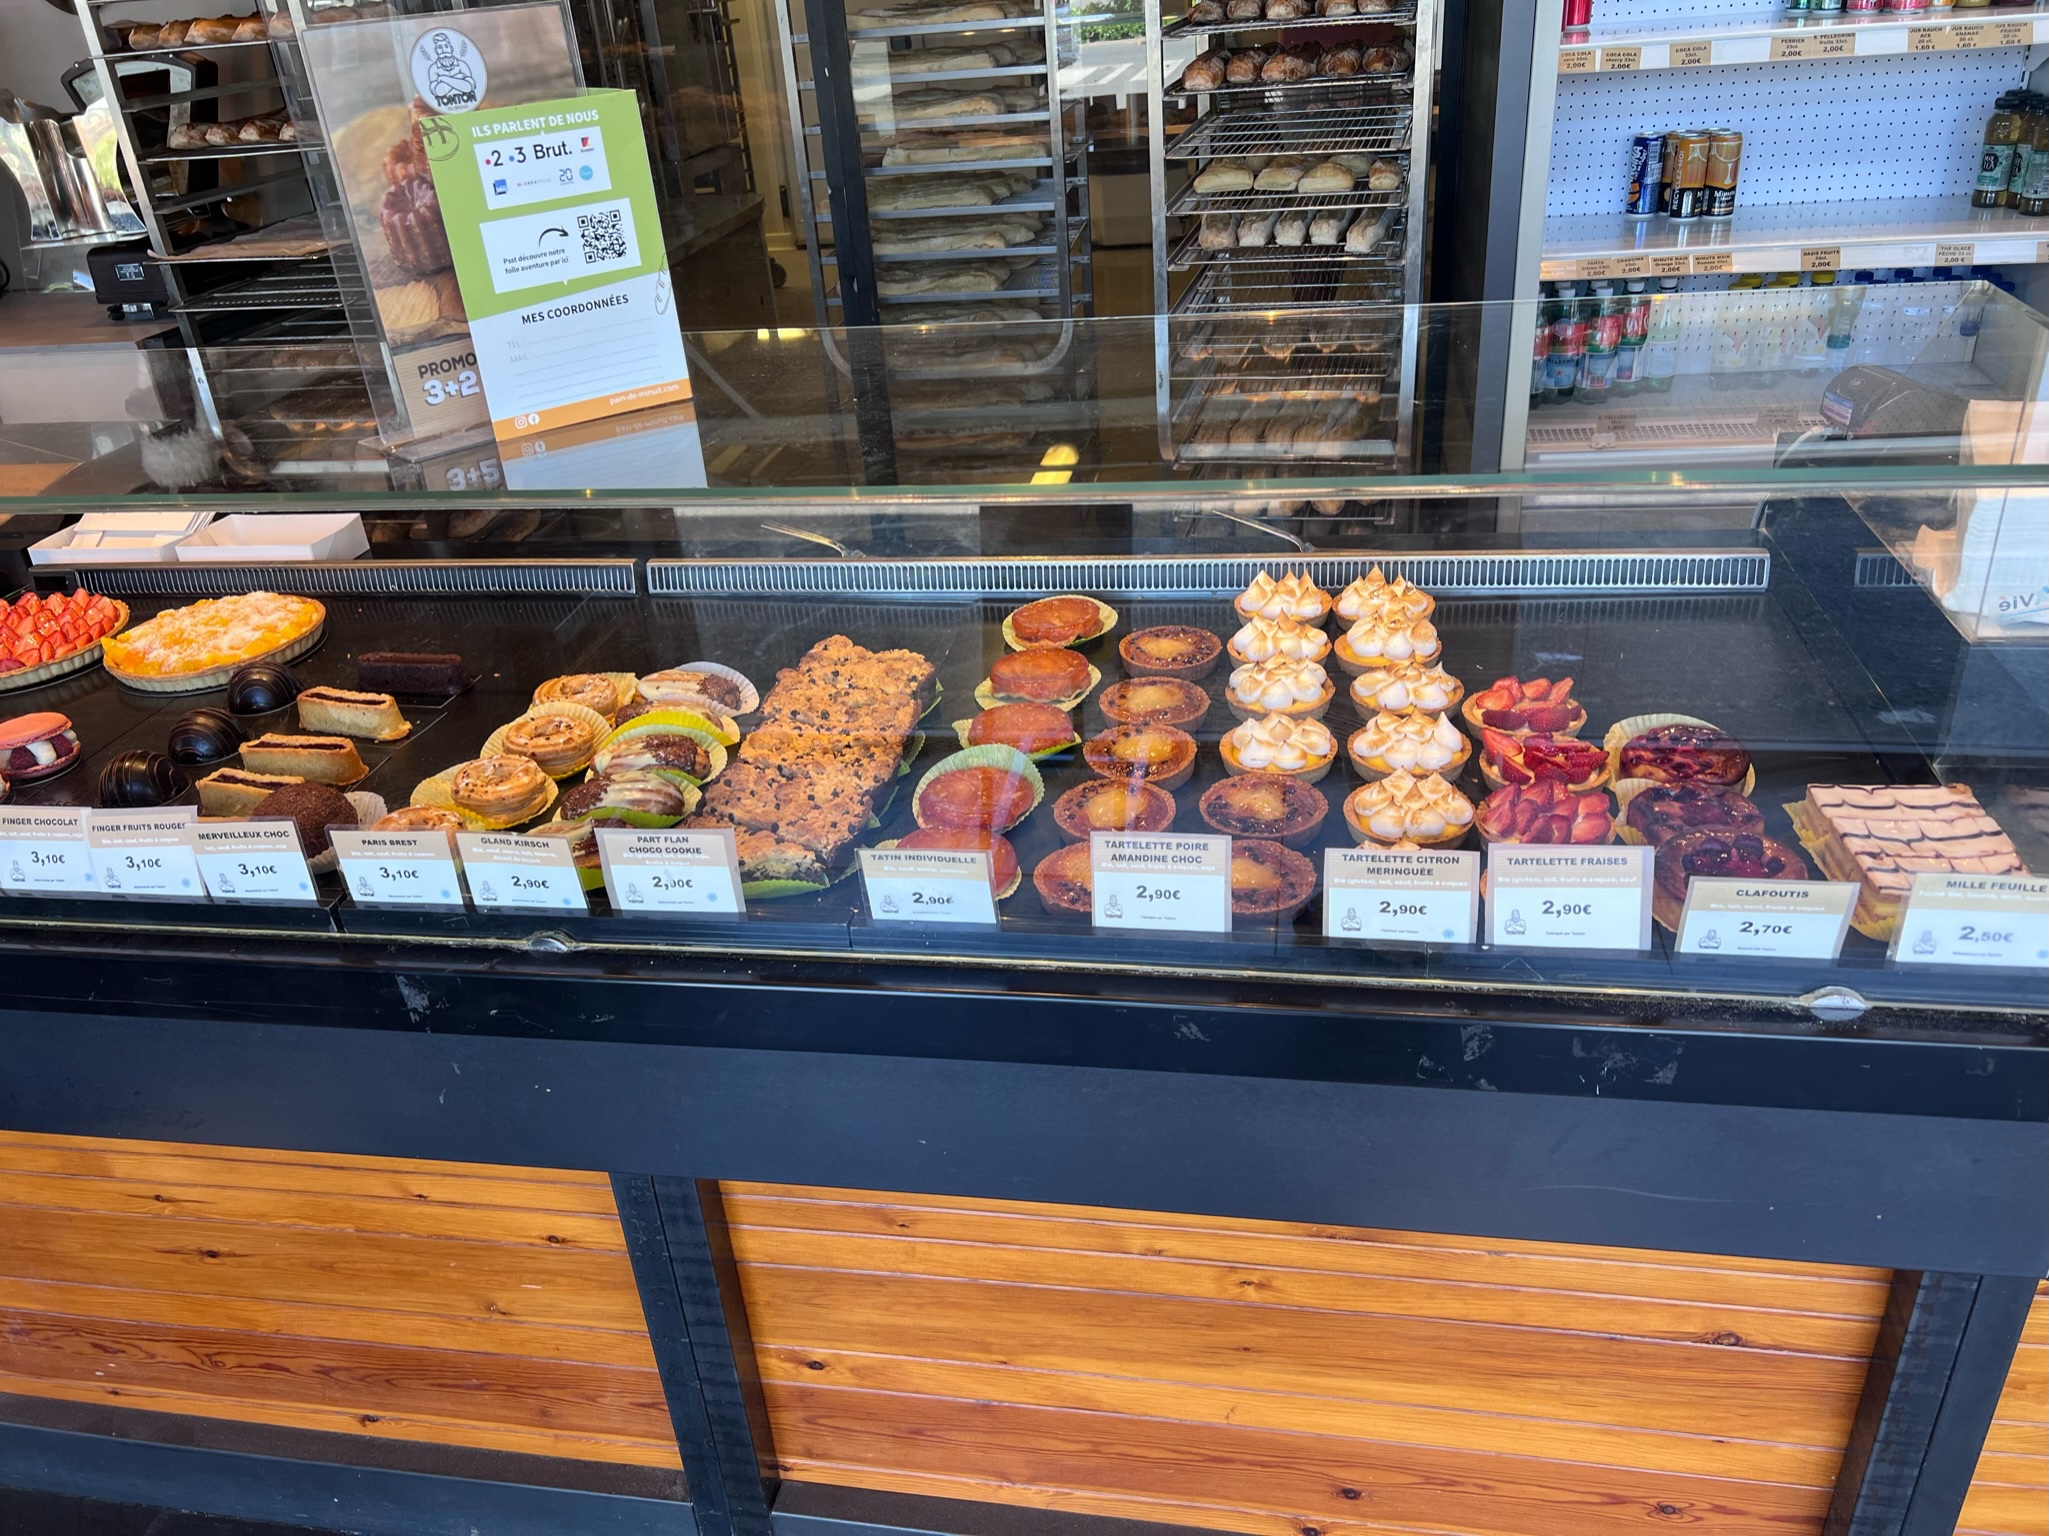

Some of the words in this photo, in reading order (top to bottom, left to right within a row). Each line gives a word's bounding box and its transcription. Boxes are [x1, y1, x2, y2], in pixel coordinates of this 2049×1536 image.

[435, 90, 477, 107] TONTON
[472, 124, 491, 138] ILS
[493, 117, 546, 135] PARLENT
[549, 115, 564, 127] DE
[566, 110, 599, 123] NOUS
[533, 141, 572, 160] Brut.
[559, 168, 573, 182] 20
[503, 257, 517, 265] Psst
[519, 252, 548, 262] découvre
[548, 248, 565, 256] notre
[521, 262, 549, 271] aventure
[561, 256, 569, 264] ici
[522, 312, 544, 325] MES
[547, 294, 629, 319] COORDONNÉES
[418, 352, 477, 379] PROMO
[423, 370, 480, 406] 3+2
[610, 383, 680, 406] pain-de-minuit.com
[34, 818, 78, 826] CHOCOLAT
[198, 832, 261, 840] MERVEILLEUX
[481, 837, 512, 845] GLAND
[514, 840, 550, 848] KIRSCH
[1105, 840, 1172, 850] TARTELETTE
[1176, 843, 1209, 851] POIRE
[31, 851, 65, 866] 3,10€
[126, 856, 161, 871] 3,10€
[905, 855, 977, 864] INDIVIDUELLE
[1111, 854, 1168, 863] AMANDINE
[1171, 855, 1202, 863] CHOC
[1342, 854, 1413, 863] TARTELETTE
[1417, 856, 1460, 864] CITRON
[238, 863, 277, 877] 3,10€
[379, 867, 419, 881] 3,10€
[1367, 867, 1434, 876] MERINGUÉE
[511, 876, 549, 889] 2,90€
[1946, 881, 1987, 889] MILLE
[1991, 882, 2048, 893] FEUILLE
[912, 892, 954, 905] 2,90€
[1136, 885, 1180, 902] 2,90€
[1736, 889, 1809, 898] CLAFOUTIS
[1380, 901, 1427, 917] 2,90€
[1542, 900, 1592, 918] 2,90€
[1738, 921, 1792, 936] 2,70€
[1959, 926, 2014, 943] 2,50€
